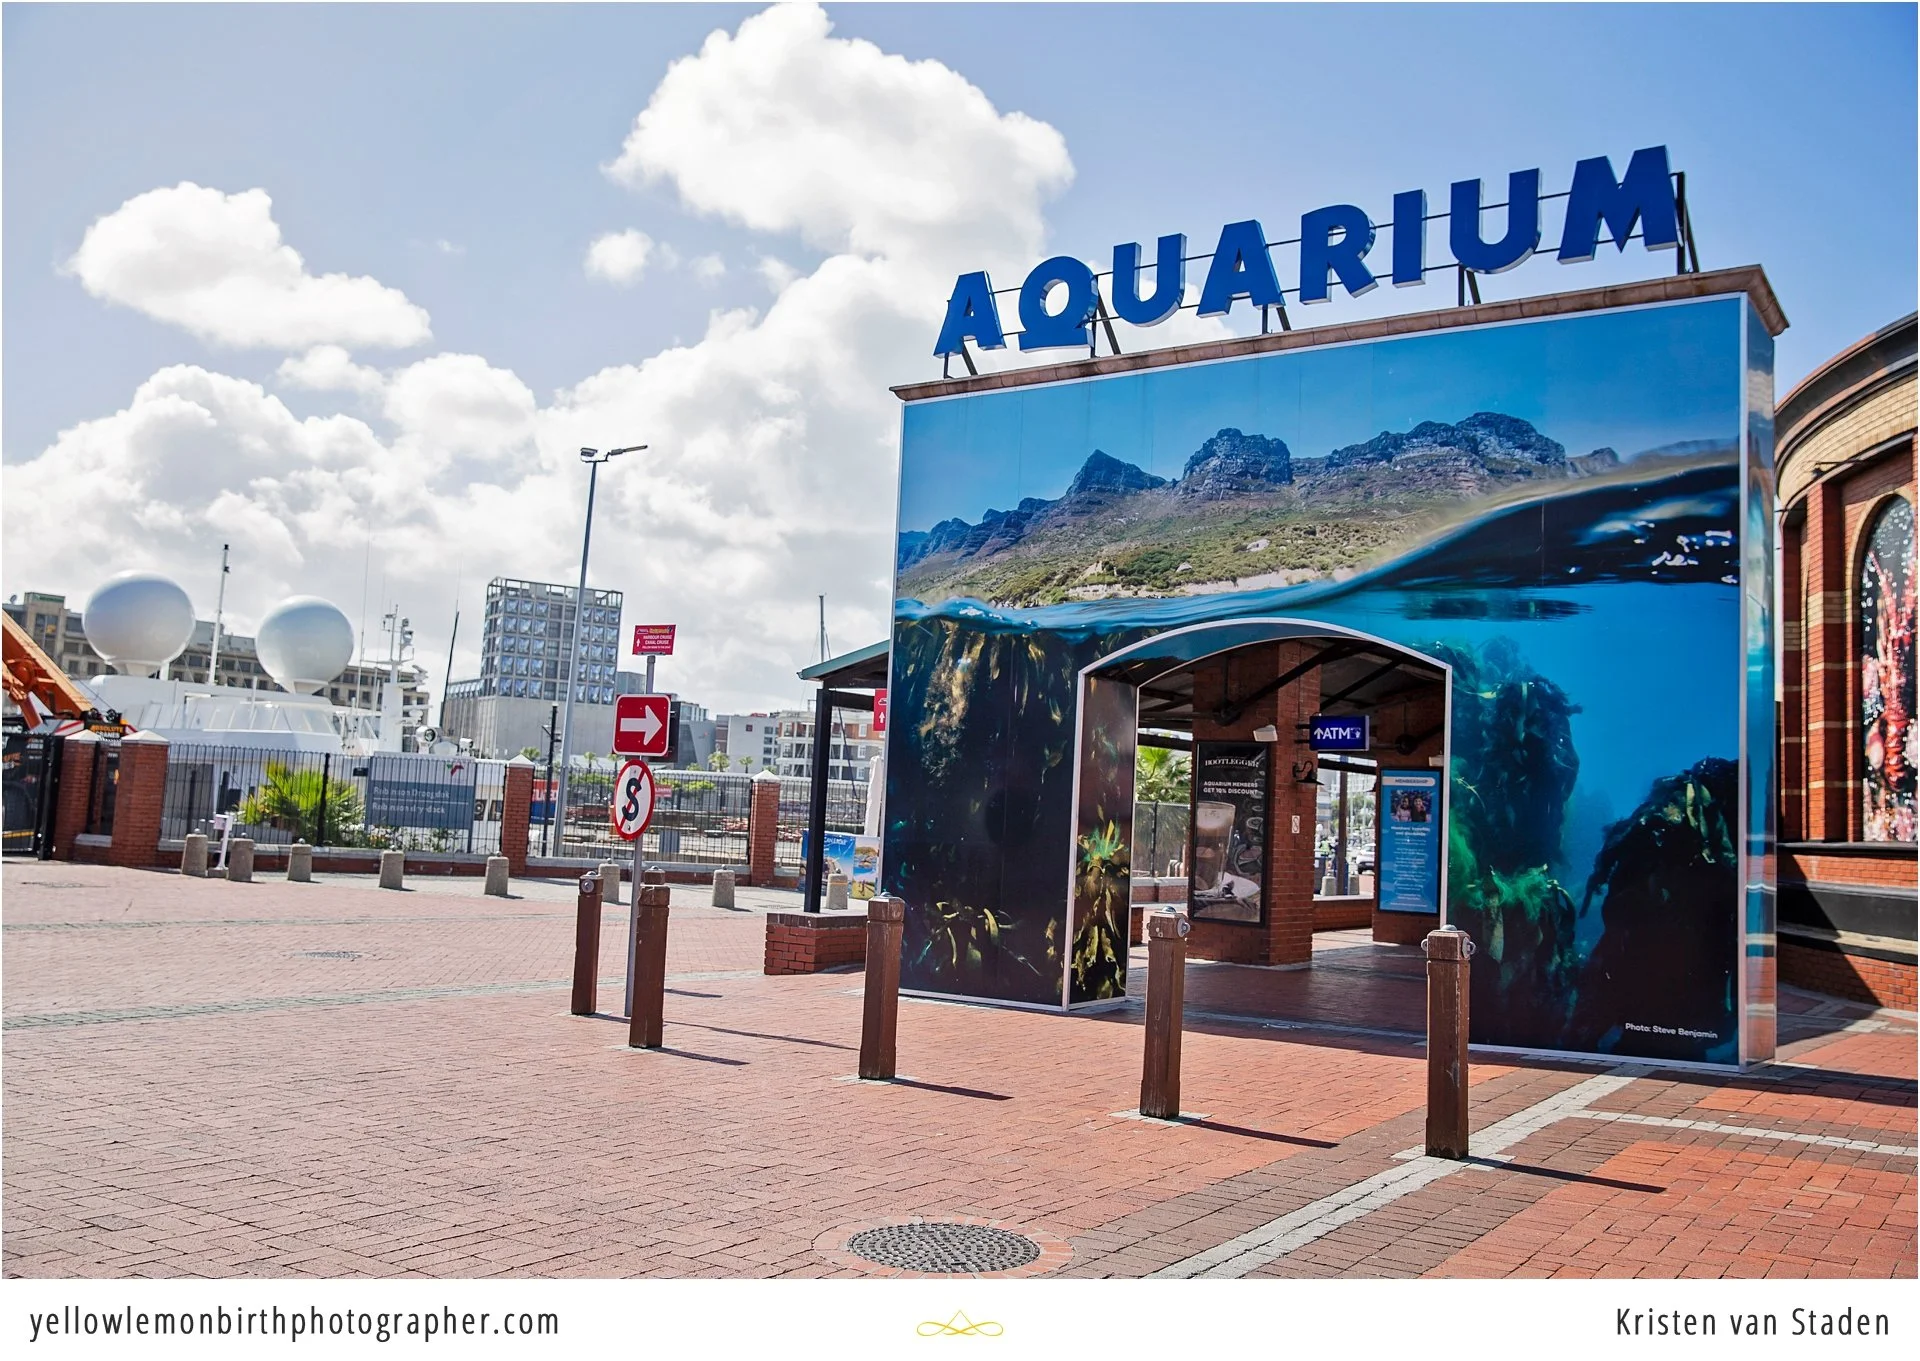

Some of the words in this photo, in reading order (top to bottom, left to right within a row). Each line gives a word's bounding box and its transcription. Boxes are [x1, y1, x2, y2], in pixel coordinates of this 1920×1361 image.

[933, 145, 1679, 358] AQUARIUM
[1322, 727, 1350, 740] ATM
[373, 786, 410, 797] Robnson
[372, 802, 409, 812] Robnson
[1625, 1022, 1652, 1033] Photo:
[1652, 1025, 1676, 1035] Steve
[1677, 1027, 1718, 1039] Benjamin
